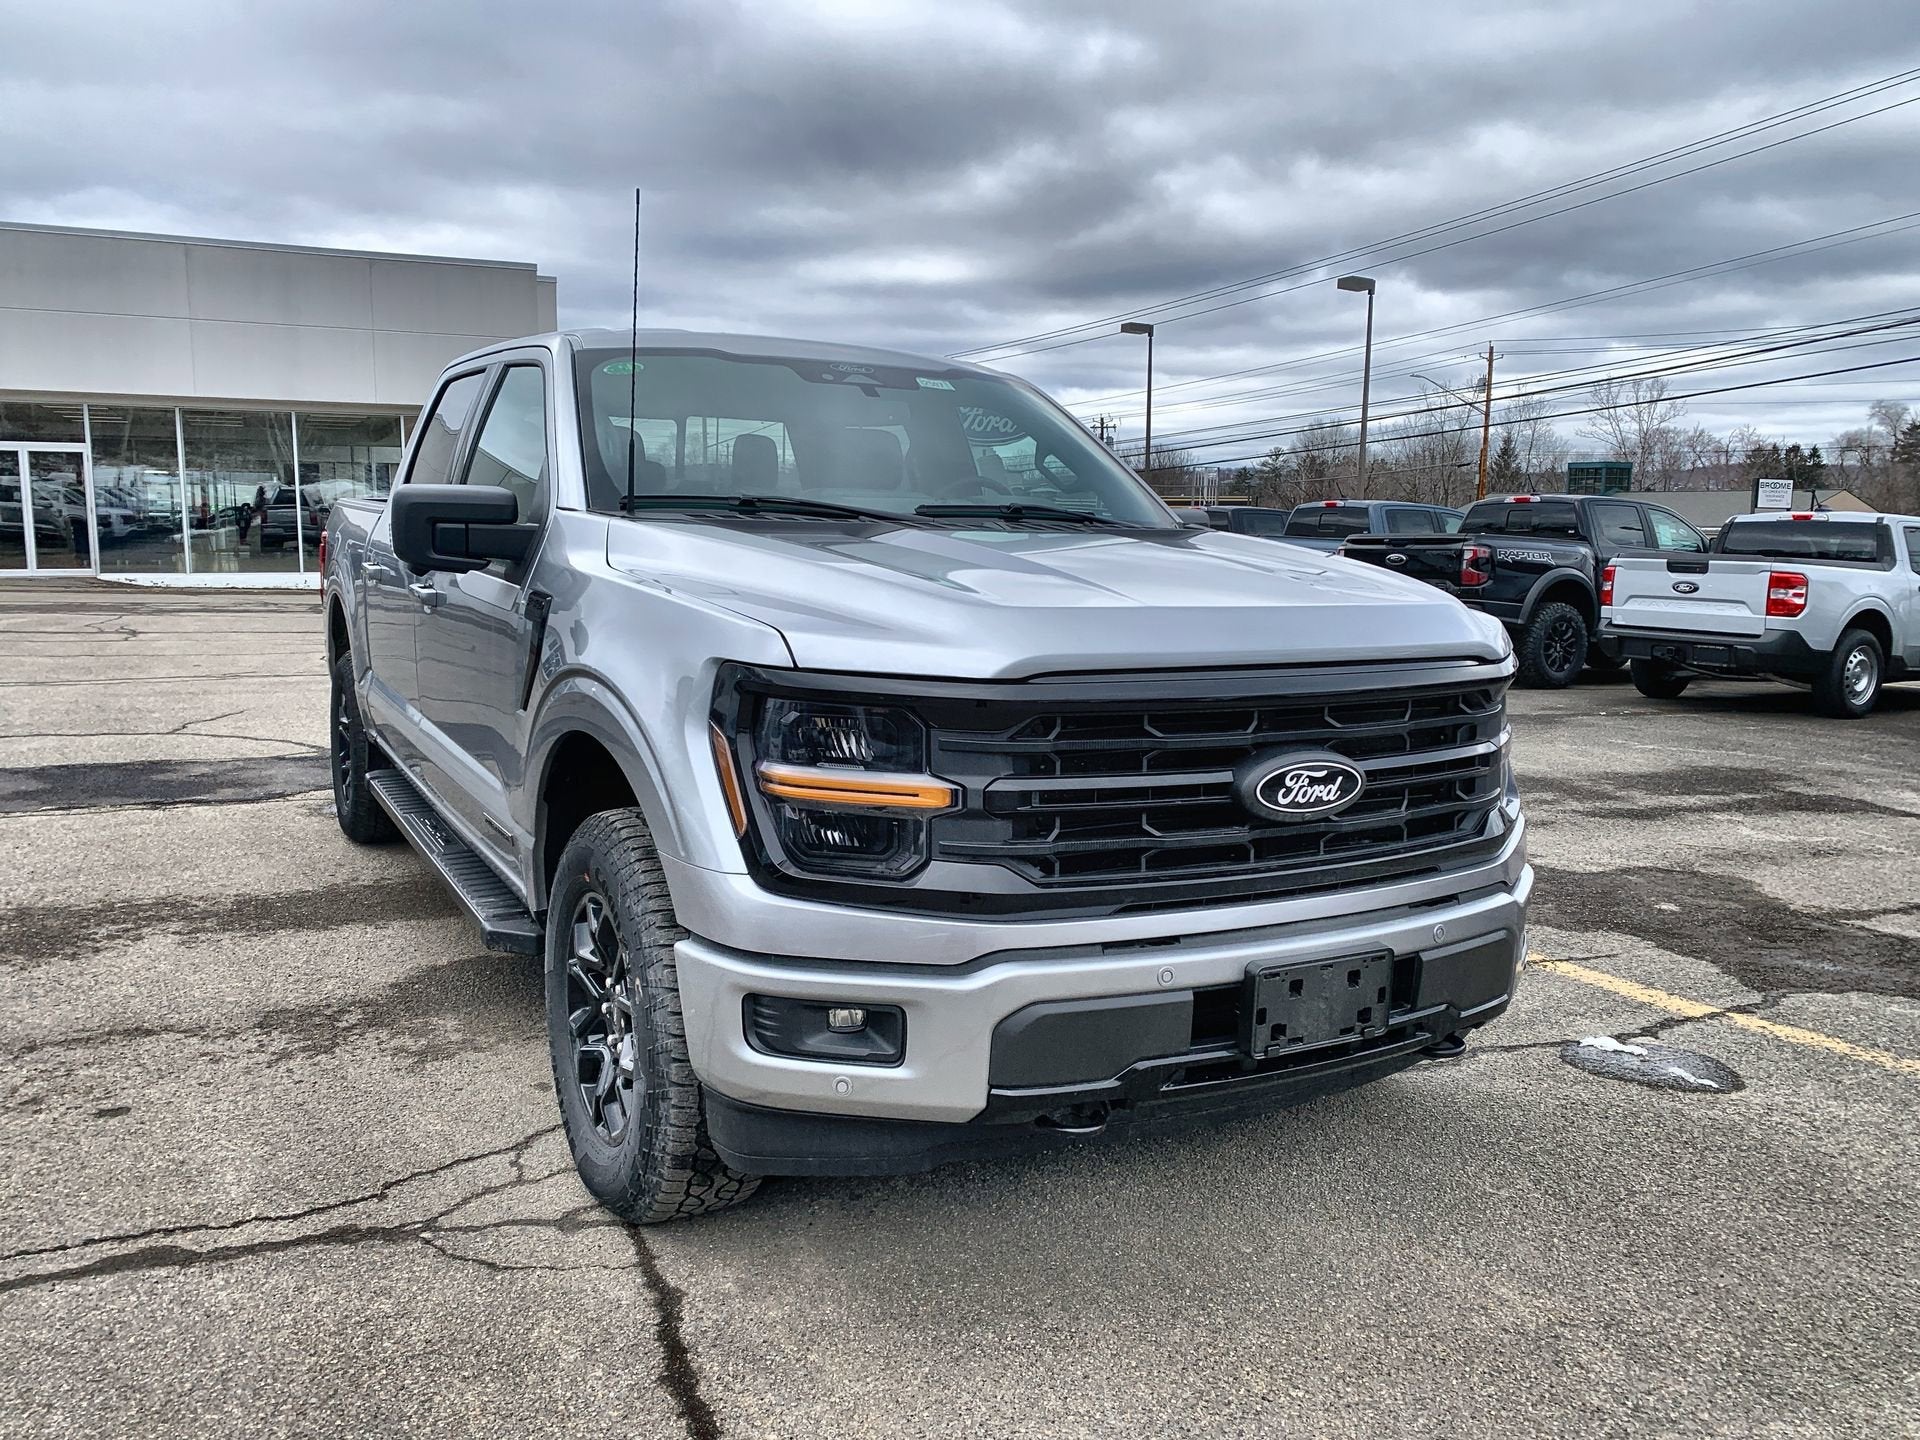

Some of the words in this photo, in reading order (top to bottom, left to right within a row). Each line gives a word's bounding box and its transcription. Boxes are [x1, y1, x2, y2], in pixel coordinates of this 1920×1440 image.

[1760, 481, 1791, 489] BROOME
[1497, 549, 1555, 565] RAPTOR
[1277, 770, 1343, 804] Ford
